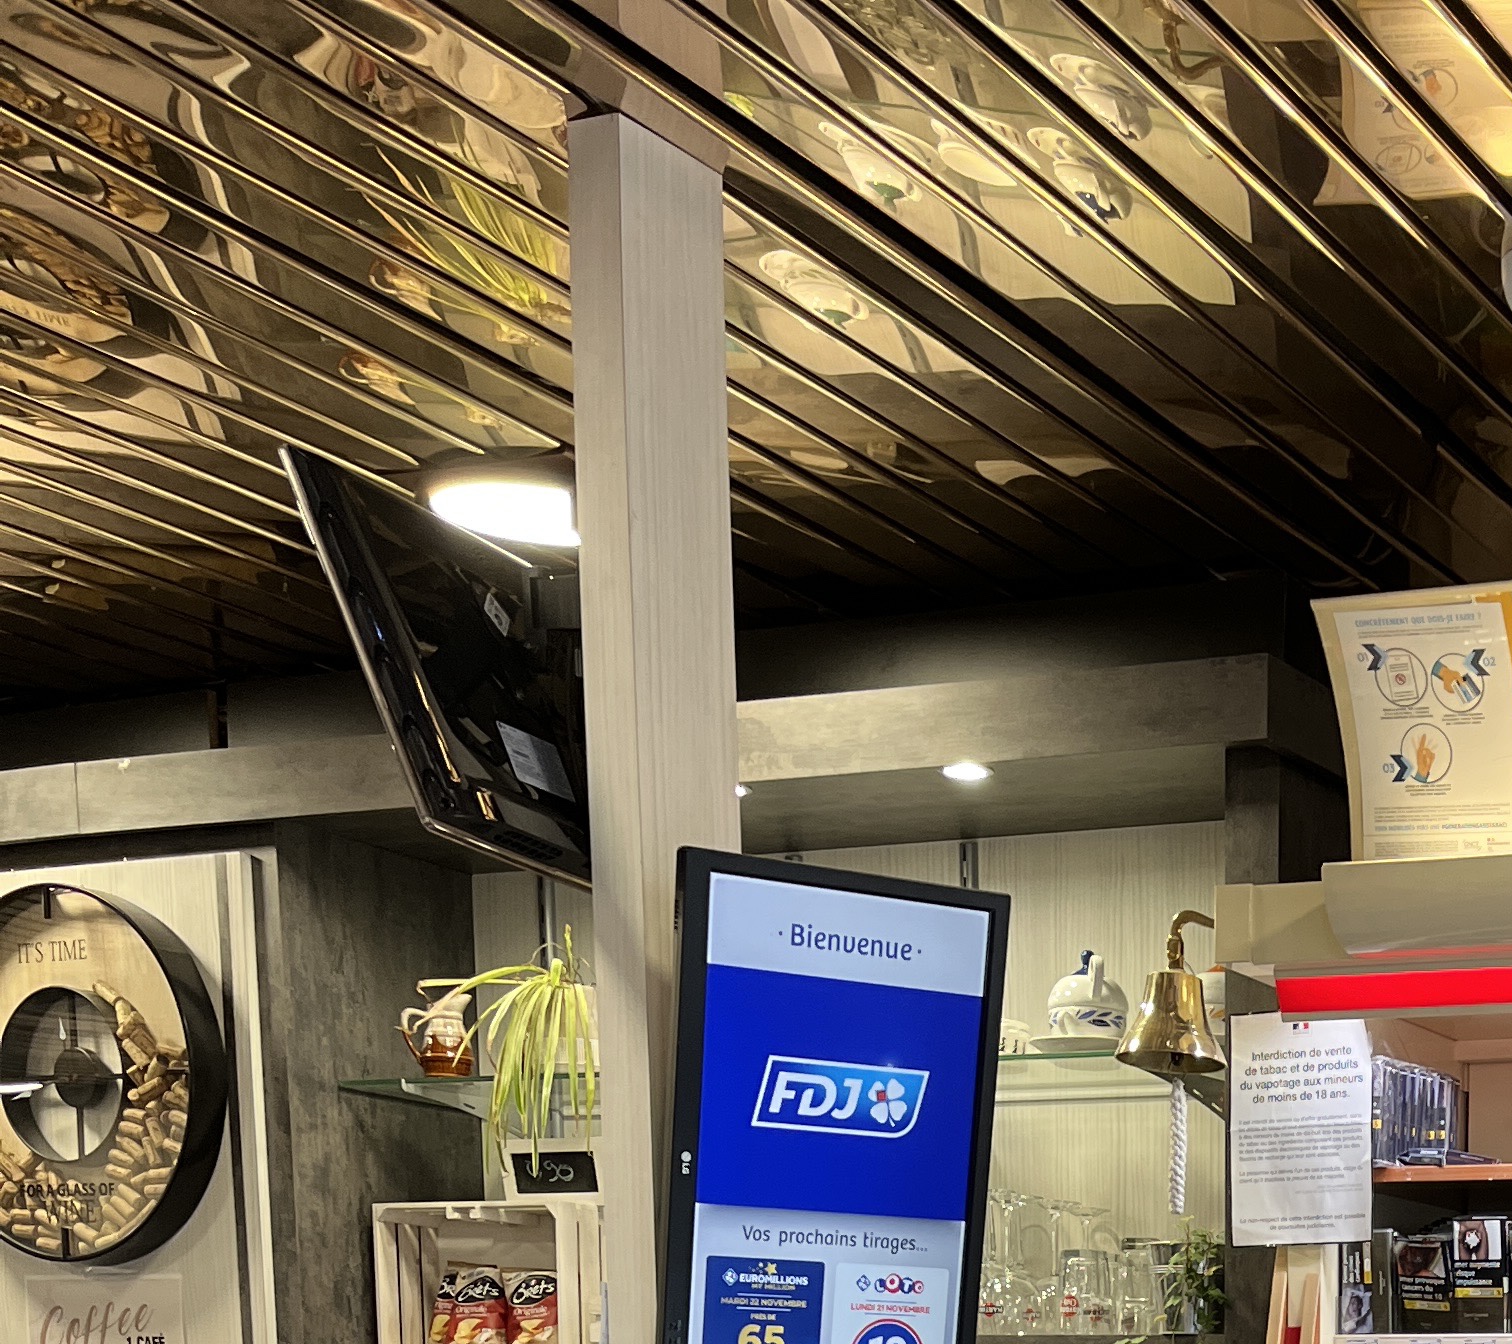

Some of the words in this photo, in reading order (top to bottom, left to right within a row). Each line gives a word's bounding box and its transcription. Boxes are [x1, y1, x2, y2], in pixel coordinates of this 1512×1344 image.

[1383, 763, 1394, 773] 03
[790, 922, 913, 961] Bienvenue
[17, 942, 44, 964] IT'S
[50, 939, 87, 962] TIME
[1252, 1051, 1306, 1062] Interdiction
[1309, 1049, 1321, 1057] de
[1325, 1046, 1351, 1056] vente
[1245, 1068, 1257, 1076] de
[1260, 1065, 1287, 1074] tabac
[1290, 1064, 1299, 1073] et
[1303, 1063, 1314, 1071] de
[1318, 1059, 1358, 1073] produits
[1240, 1082, 1252, 1090] du
[1255, 1078, 1301, 1091] vapotage
[1303, 1078, 1321, 1086] aux
[1324, 1074, 1363, 1084] mineurs
[768, 1070, 863, 1119] FDJ
[1253, 1095, 1264, 1103] de
[1268, 1093, 1297, 1102] moins
[1300, 1091, 1312, 1100] de
[1316, 1090, 1327, 1099] 18
[19, 1184, 44, 1198] FOR
[57, 1183, 96, 1197] GLASS
[99, 1182, 115, 1197] OF
[46, 1200, 96, 1224] WINE
[743, 1225, 770, 1241] Vos
[779, 1228, 856, 1246] prochains
[739, 1272, 808, 1286] EUROMILLIONS
[874, 1273, 925, 1294] LOTO
